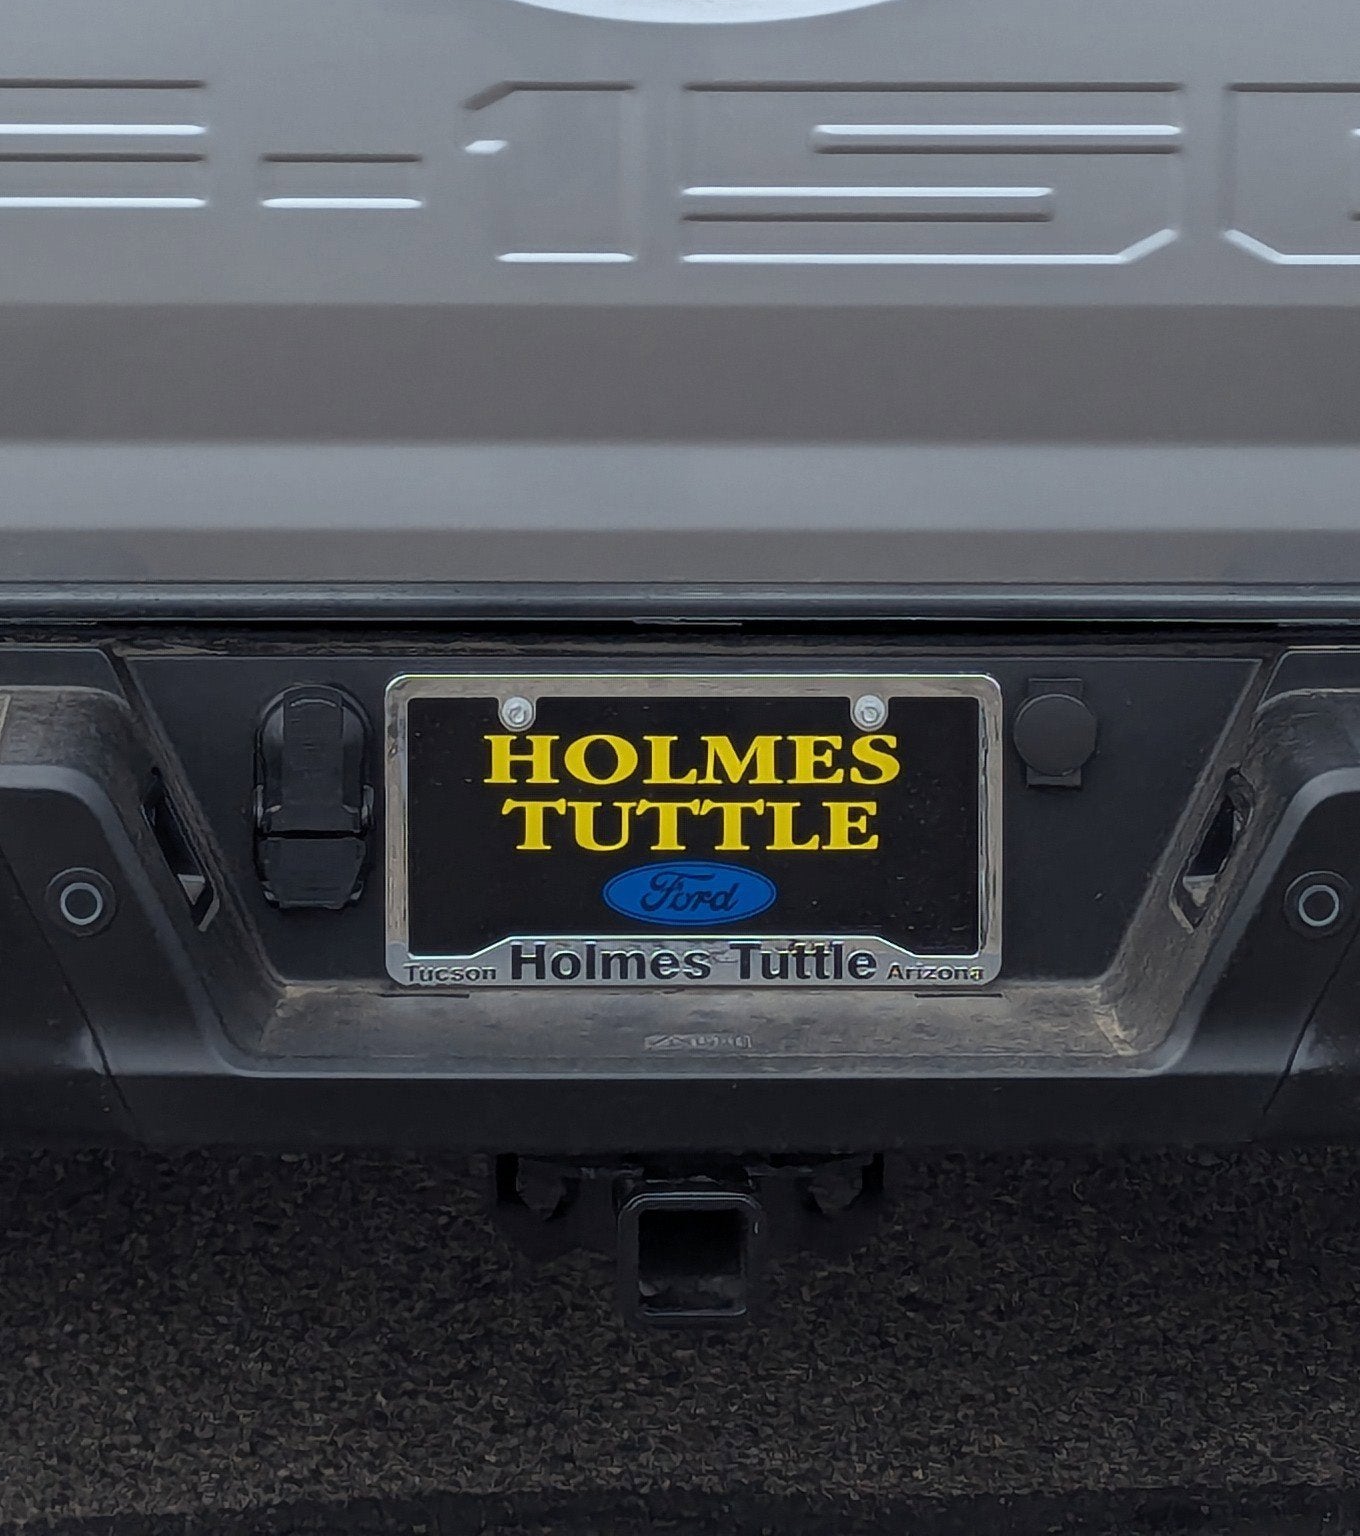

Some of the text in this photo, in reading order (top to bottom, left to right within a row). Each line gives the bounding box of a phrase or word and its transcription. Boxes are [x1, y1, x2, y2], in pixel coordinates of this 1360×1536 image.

[483, 734, 901, 786] HOLMES
[501, 797, 880, 852] TUTTLE
[639, 871, 741, 913] Ford
[403, 941, 985, 983] Tucson Holmes Tuttle Arizona
